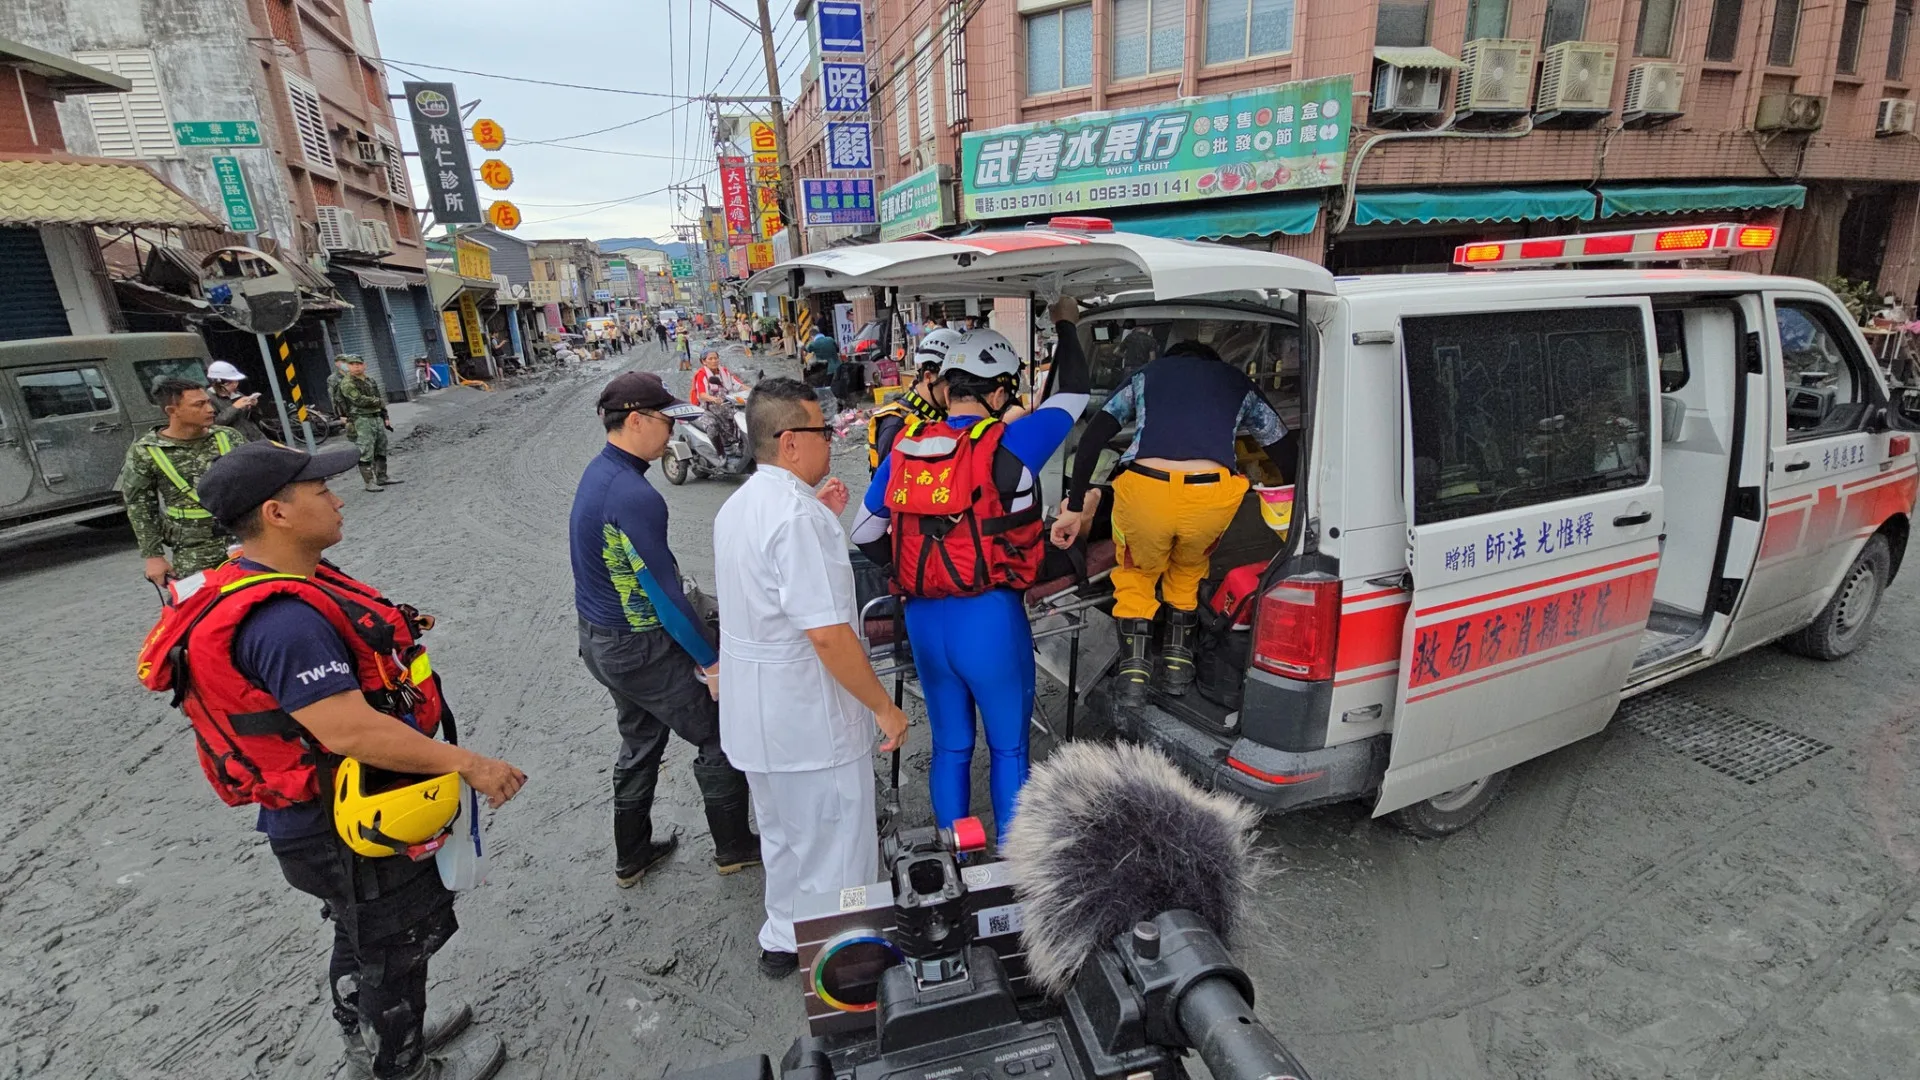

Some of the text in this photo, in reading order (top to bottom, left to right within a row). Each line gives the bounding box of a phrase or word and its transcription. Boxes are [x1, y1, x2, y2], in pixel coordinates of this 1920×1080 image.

[1213, 102, 1319, 132] 零售 禮盒
[976, 114, 1187, 185] 武義水果行
[1212, 125, 1318, 155] 批發 節慶
[429, 124, 464, 212] 柏仁診所
[480, 122, 514, 226] 豆花店
[1105, 161, 1170, 176] WUYI FRUIT
[219, 164, 248, 215] 中正路一段
[1089, 178, 1190, 201] 0963-301141
[892, 486, 951, 505] 消防
[994, 1052, 1019, 1063] AUDIO
[925, 1066, 964, 1080] THUMBNAIL
